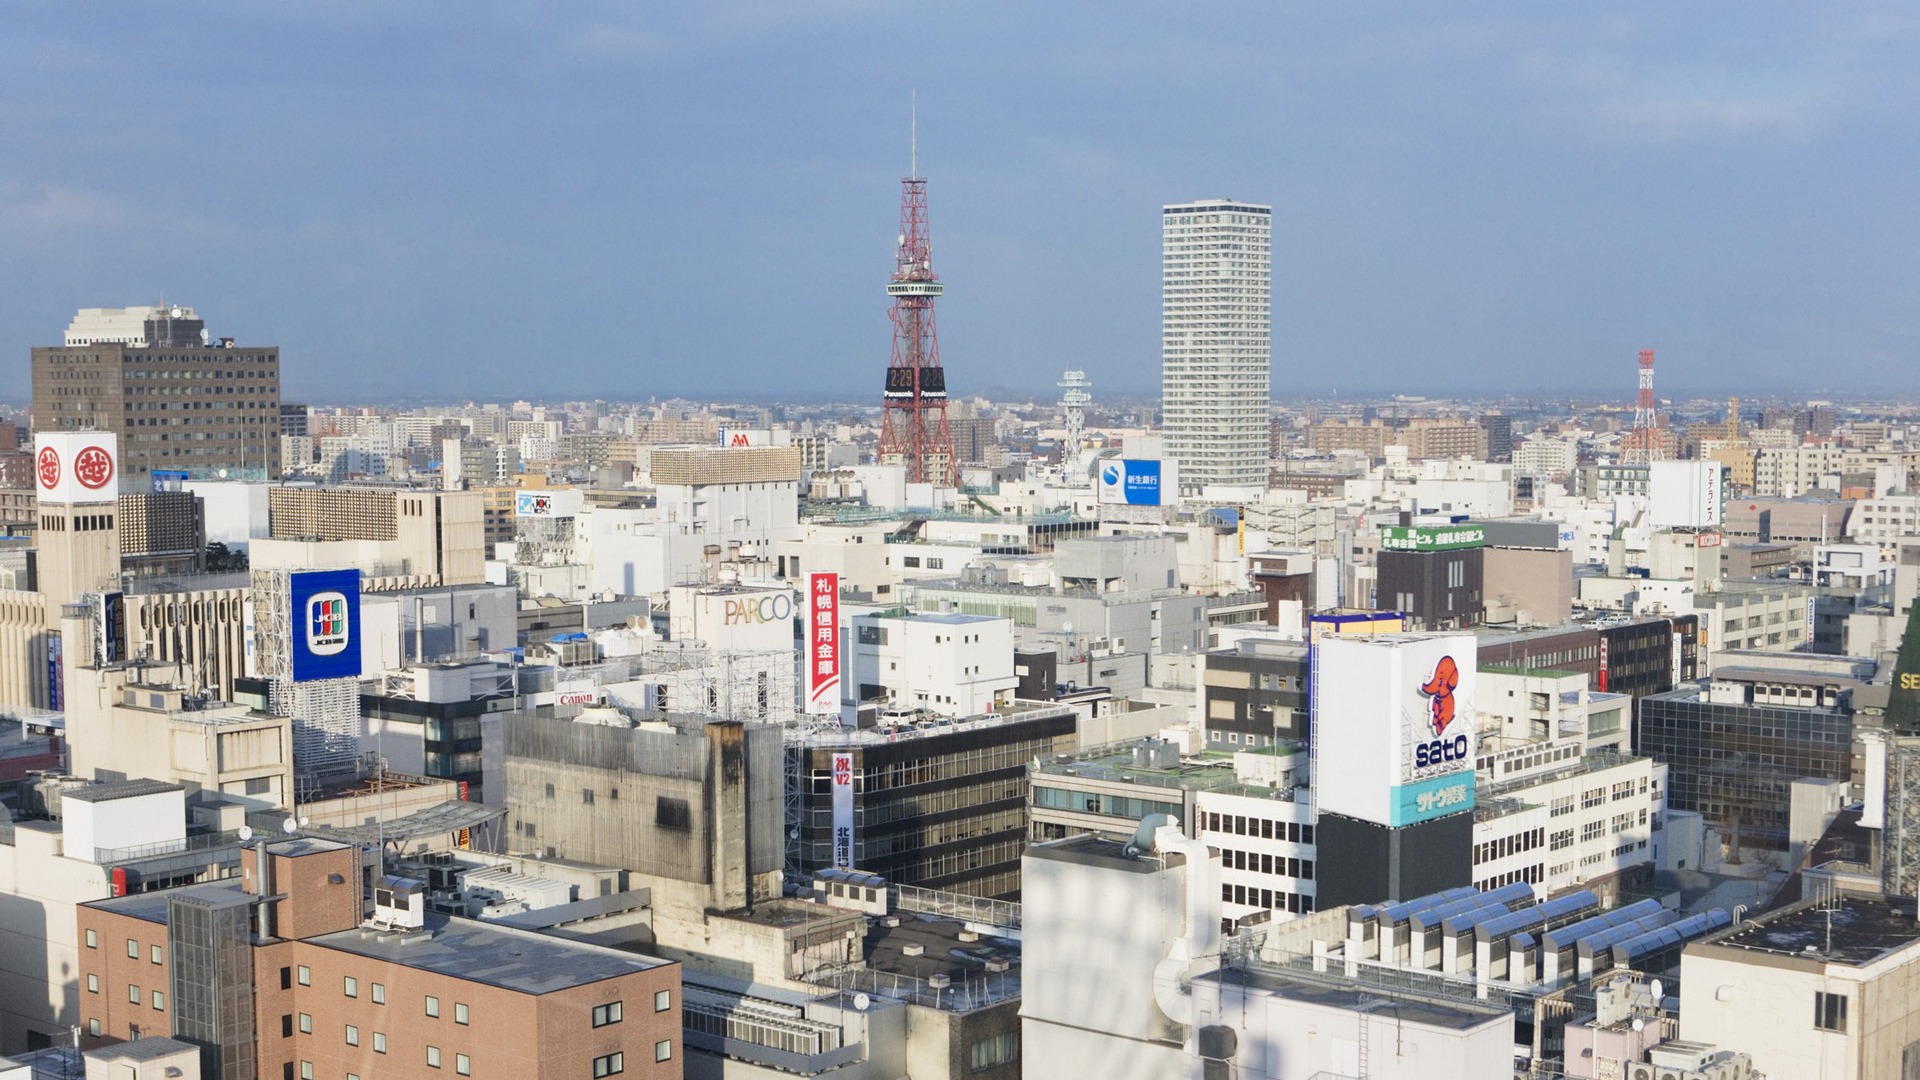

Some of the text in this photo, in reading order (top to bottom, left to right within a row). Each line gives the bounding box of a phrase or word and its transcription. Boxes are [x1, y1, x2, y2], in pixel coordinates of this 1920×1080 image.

[890, 369, 912, 387] 2:29
[884, 390, 914, 398] Panasonic
[920, 390, 946, 398] Panasonic
[1127, 474, 1158, 485] 新生銀行
[724, 594, 791, 625] PARCO
[314, 613, 342, 623] JCB
[816, 578, 835, 675] 札幌信用金庫
[1900, 672, 1920, 690] SE
[560, 694, 593, 705] Canon
[1416, 734, 1468, 768] sato
[836, 757, 851, 772] 祝
[836, 773, 851, 786] V2
[1417, 784, 1467, 813] サトウ製薬
